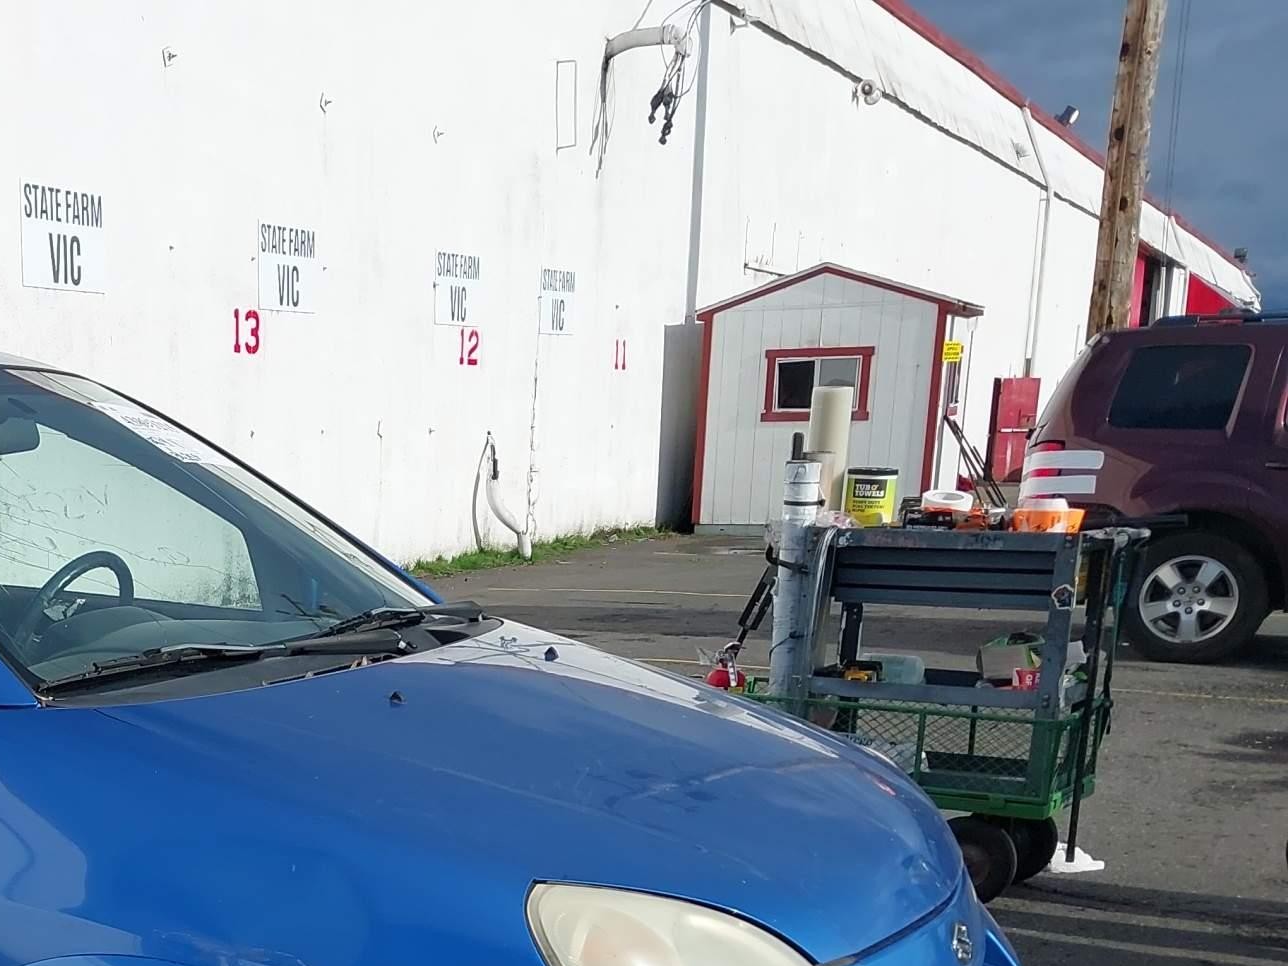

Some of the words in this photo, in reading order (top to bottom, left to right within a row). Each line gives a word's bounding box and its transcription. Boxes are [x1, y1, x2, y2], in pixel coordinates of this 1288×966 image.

[23, 183, 62, 222] STATE
[65, 190, 103, 229] FARM
[48, 232, 82, 287] VIC
[260, 223, 287, 255] STATE
[288, 227, 315, 259] FARM
[437, 251, 459, 278] STATE
[459, 255, 480, 280] FARM
[543, 268, 558, 291] STATE
[558, 270, 575, 293] FARM
[277, 263, 300, 308] VIC
[450, 285, 467, 323] VIC
[232, 309, 261, 355] 13
[551, 298, 565, 332] VIC
[459, 329, 480, 367] 12
[614, 339, 627, 371] 11
[855, 483, 871, 491] TUB
